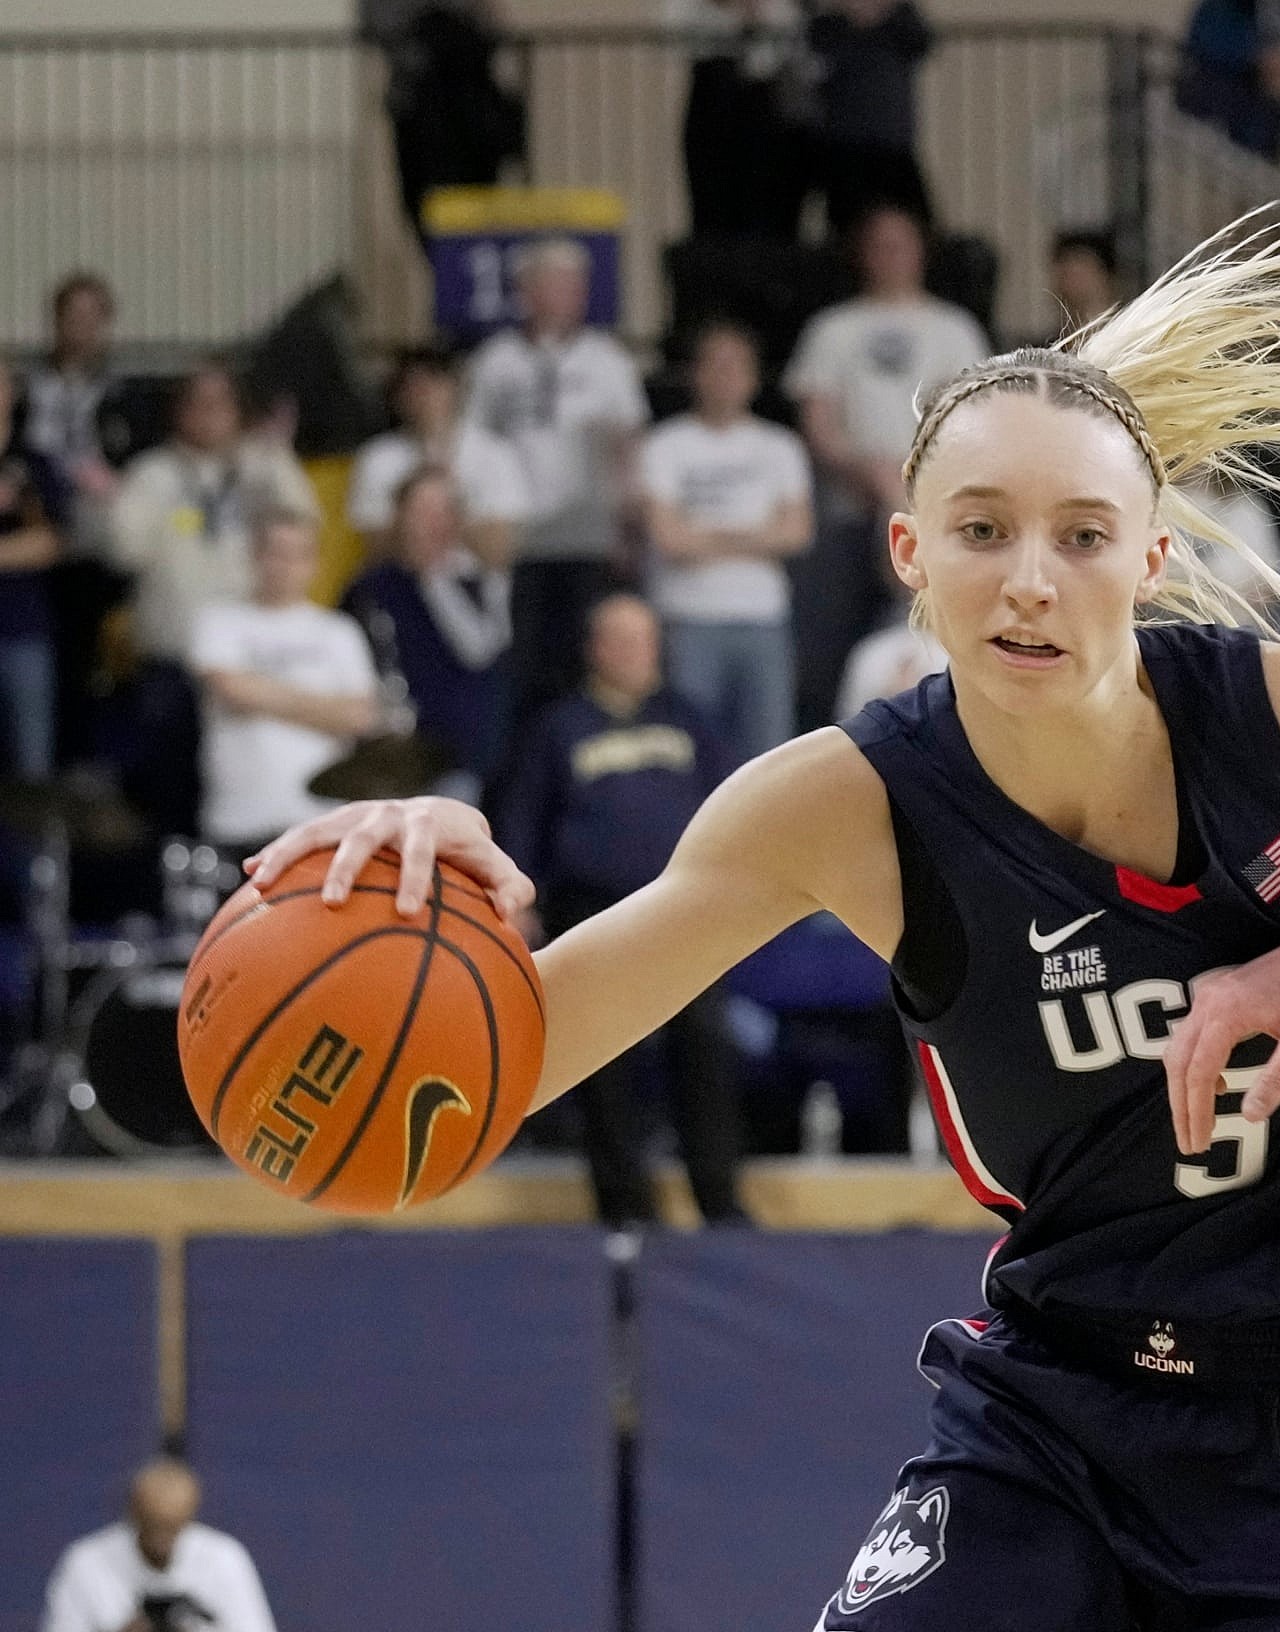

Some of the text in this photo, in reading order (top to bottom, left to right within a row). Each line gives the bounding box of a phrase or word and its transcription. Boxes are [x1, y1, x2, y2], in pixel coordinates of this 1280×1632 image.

[1041, 963, 1107, 991] CHANGE
[1043, 947, 1101, 974] BE THE
[1037, 972, 1194, 1073] UC
[244, 1022, 365, 1183] ELITE
[1173, 1063, 1270, 1199] 5
[1134, 1351, 1195, 1375] UCONN
